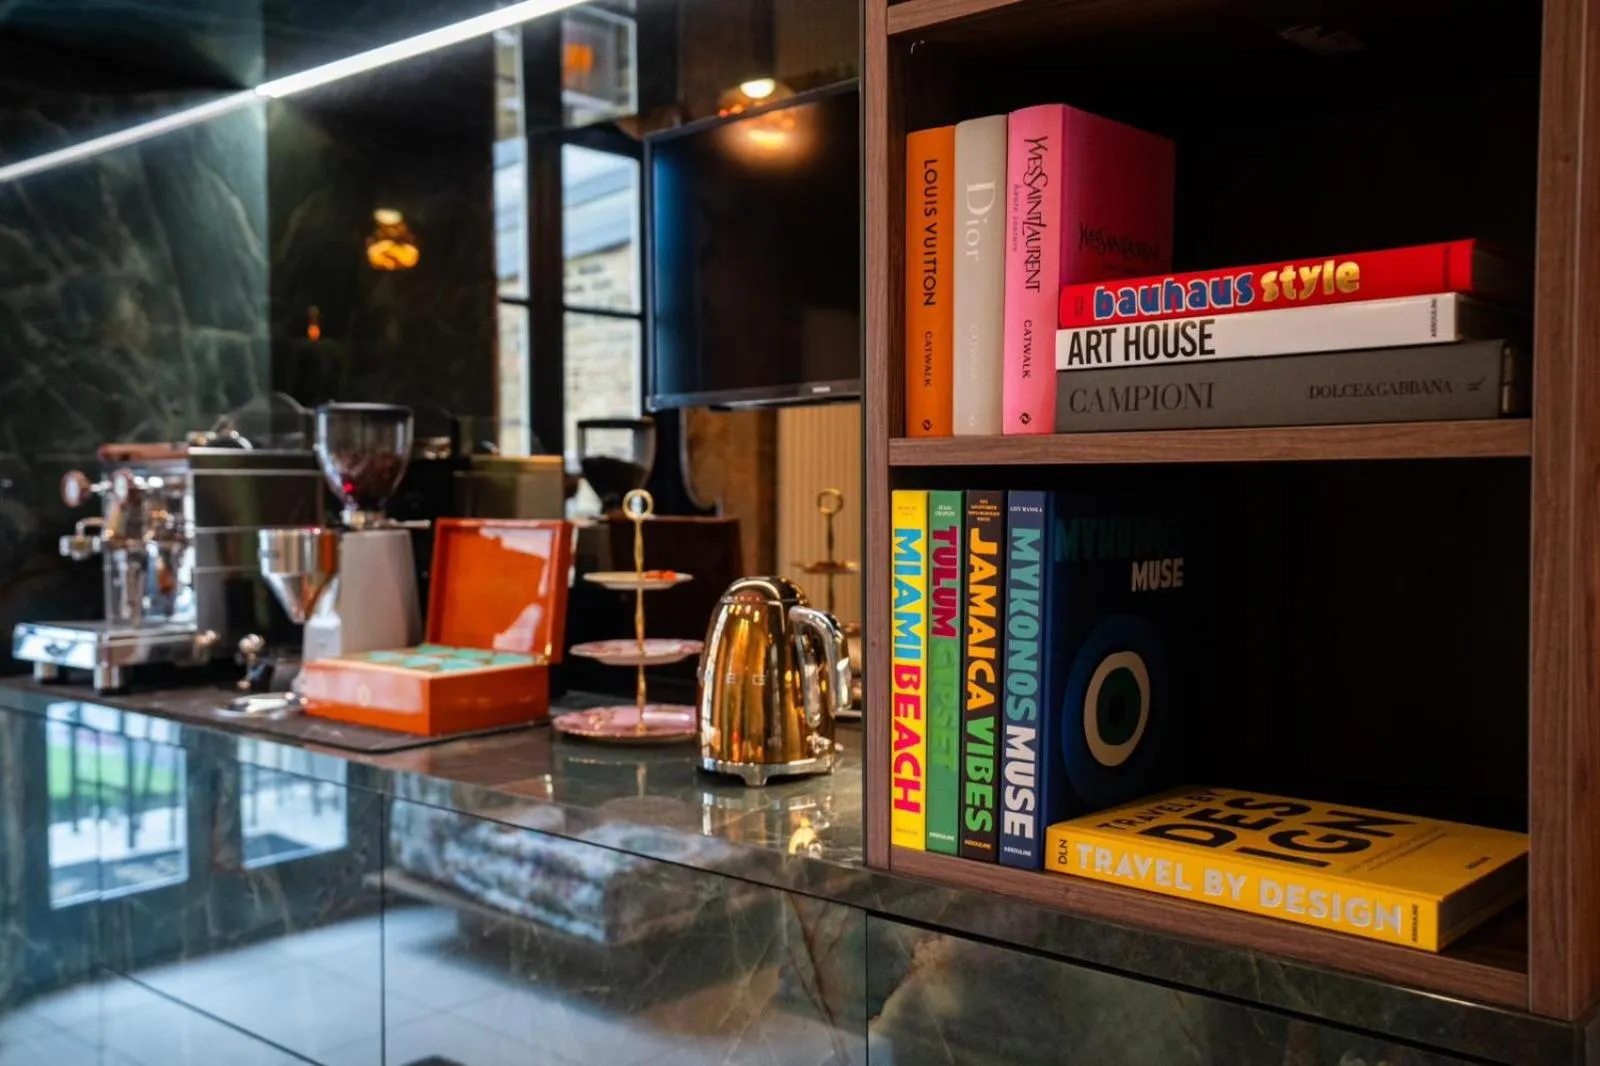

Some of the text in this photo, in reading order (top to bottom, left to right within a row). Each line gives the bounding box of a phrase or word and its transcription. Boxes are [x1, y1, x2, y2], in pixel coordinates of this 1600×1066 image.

[922, 158, 938, 307] LOUIS VUITTON
[966, 180, 996, 261] Dior
[1093, 271, 1255, 320] bauhaus
[1260, 259, 1361, 304] style
[923, 330, 933, 387] CATWALK
[1022, 319, 1033, 379] CATWALK
[1067, 318, 1216, 366] ART HOUSE
[1069, 381, 1216, 415] CAMPIONI
[1308, 378, 1454, 401] DOLCE&GABBANA
[893, 528, 922, 661] MIAMI
[931, 525, 958, 638] TULUM
[1130, 557, 1185, 593] MUSE
[967, 527, 998, 711] JAMAICA
[1003, 527, 1041, 840] MYKONOS MUSE
[893, 664, 922, 815] BEACH
[965, 716, 995, 834] VIBES
[1097, 802, 1197, 832] TRAVEL
[1137, 797, 1313, 848] DES
[1233, 810, 1418, 868] IGN
[1058, 838, 1069, 865] DLN
[1076, 842, 1402, 936] TRAVEL BY DESIGN
